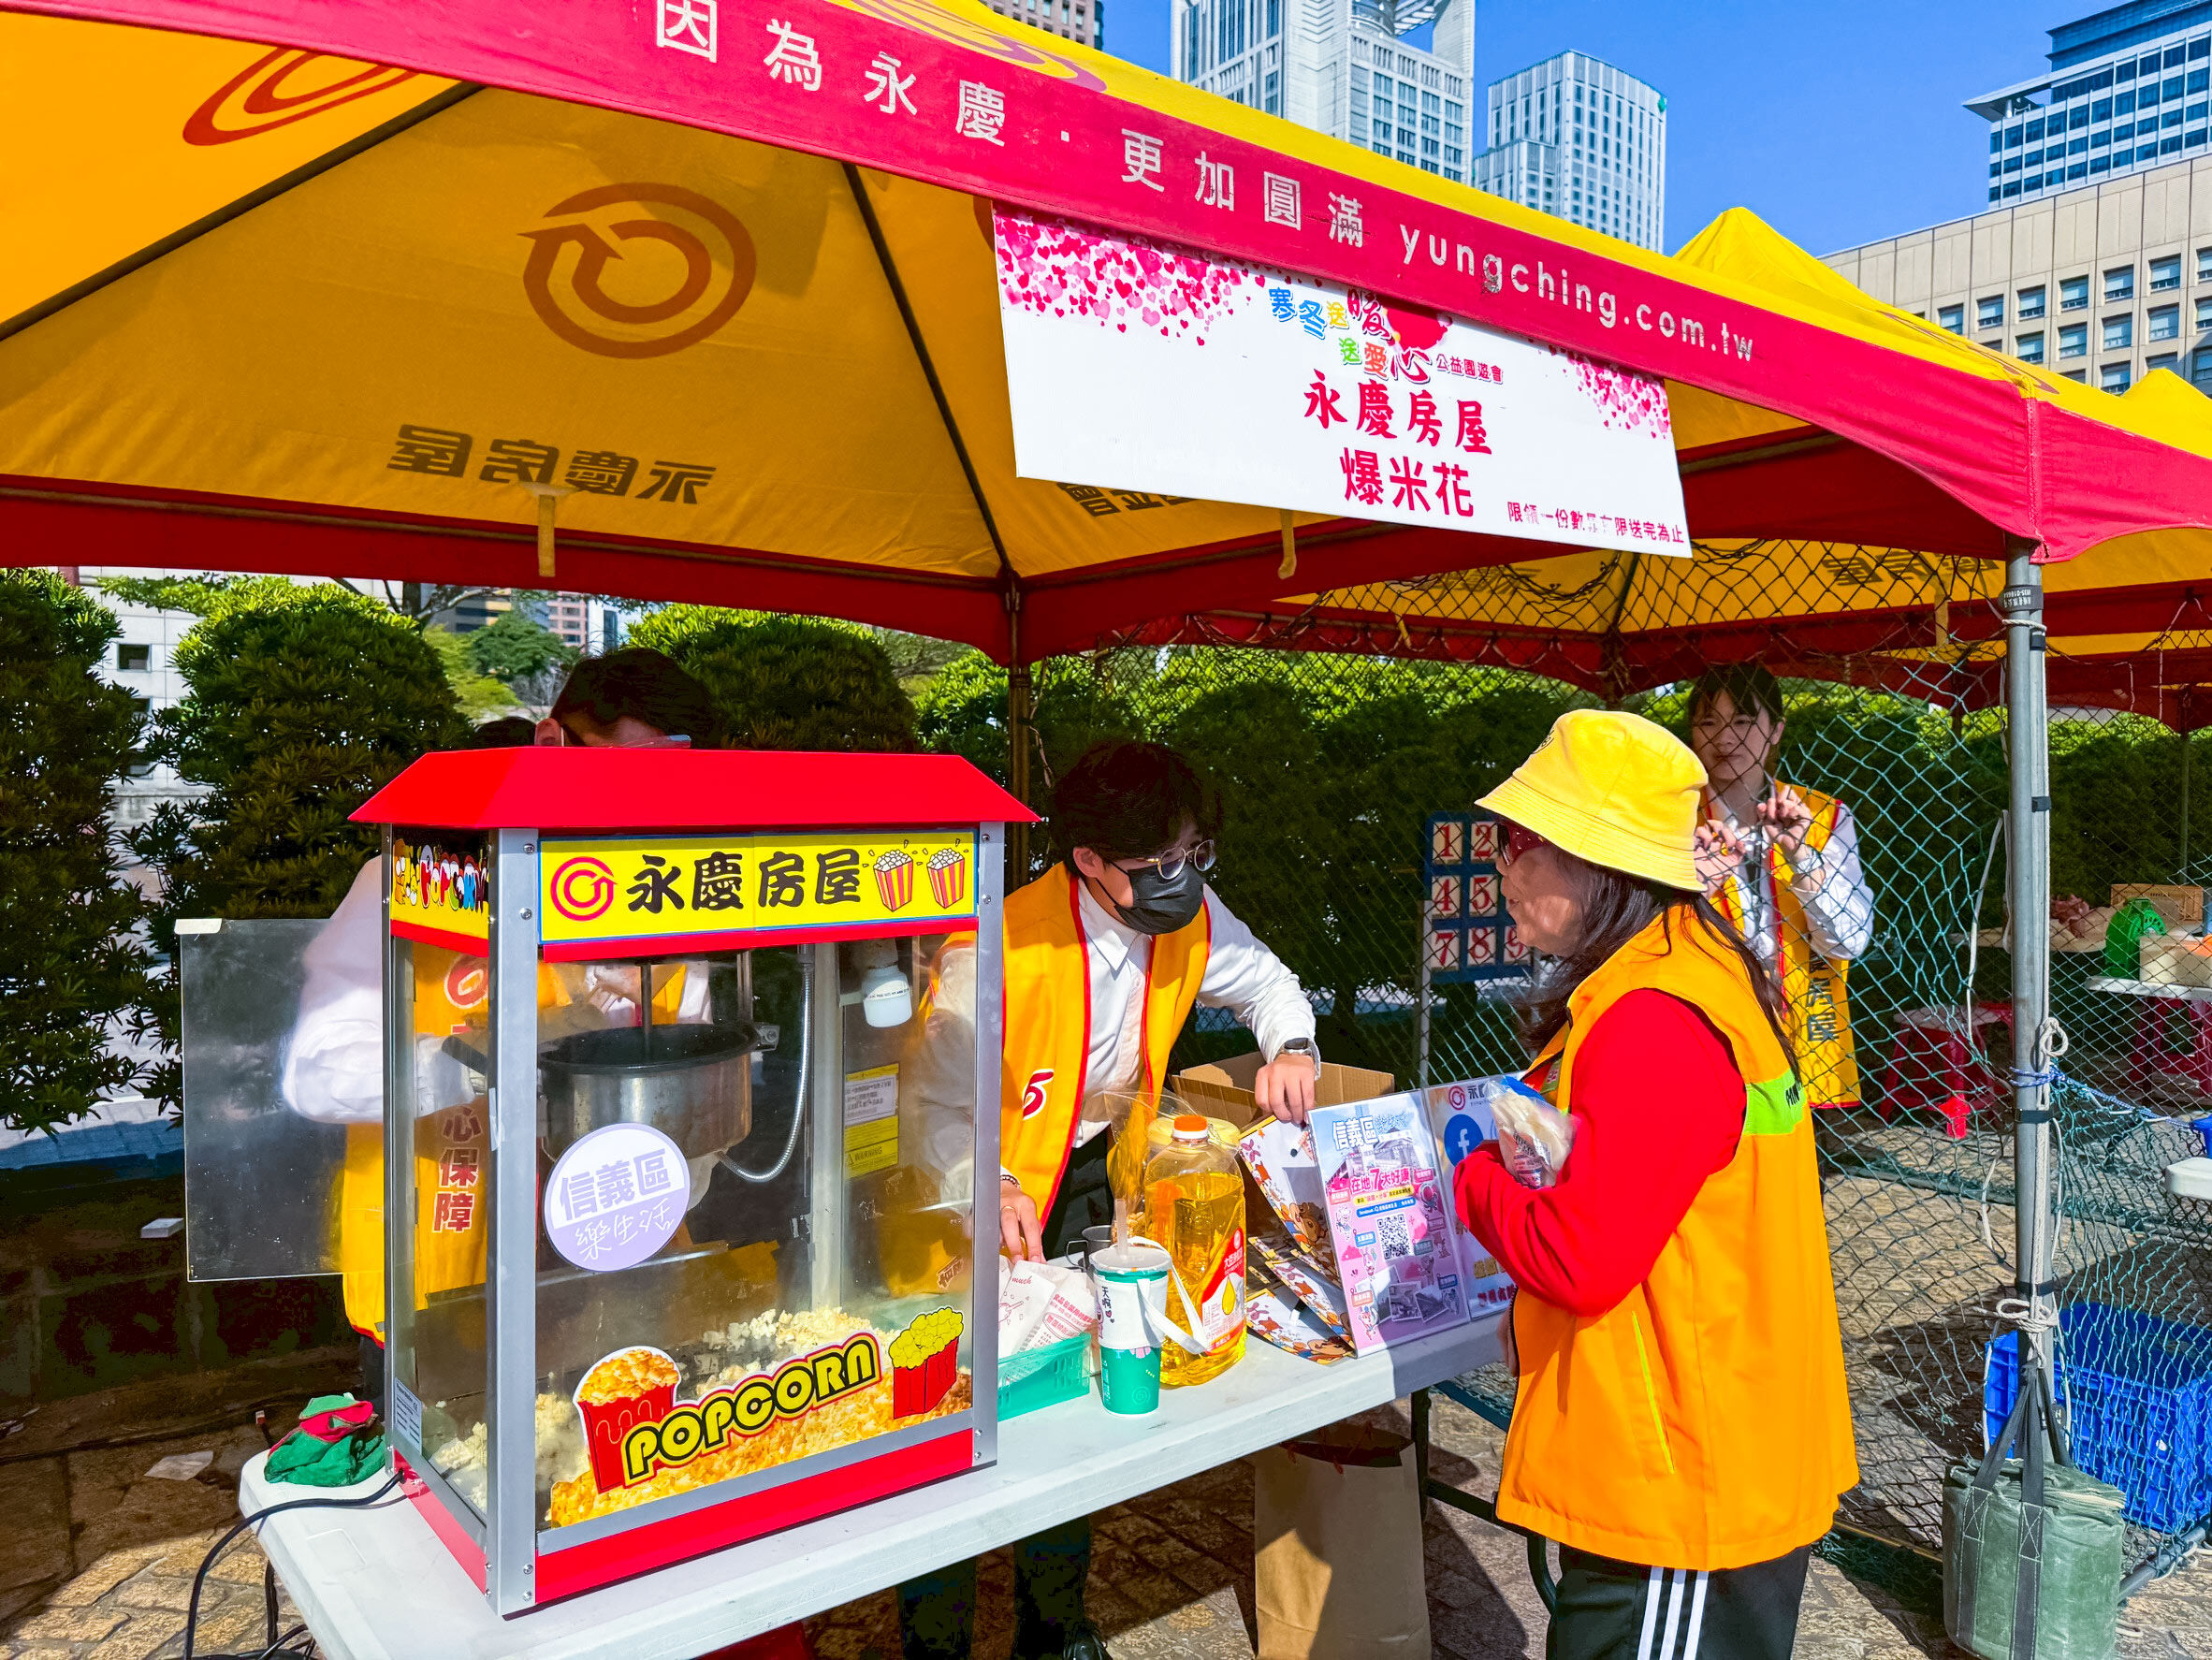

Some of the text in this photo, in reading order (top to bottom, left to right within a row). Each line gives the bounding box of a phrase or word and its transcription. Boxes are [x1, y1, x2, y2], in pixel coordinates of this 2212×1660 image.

[1400, 224, 1754, 362] yungching.com.tw
[1303, 369, 1493, 456] 永慶房屋
[1339, 446, 1475, 517] 爆米花
[1438, 824, 1453, 857] 1
[1475, 824, 1492, 858] 2
[627, 847, 862, 911] 永慶房屋
[1434, 879, 1452, 911] 4
[1472, 877, 1491, 910] 5
[1435, 932, 1454, 967] 7
[1470, 927, 1490, 959] 8
[1332, 1114, 1379, 1152] 信義區
[559, 1148, 672, 1223] 信義區
[575, 1197, 675, 1262] 樂生活
[625, 1339, 878, 1479] POPCORN
